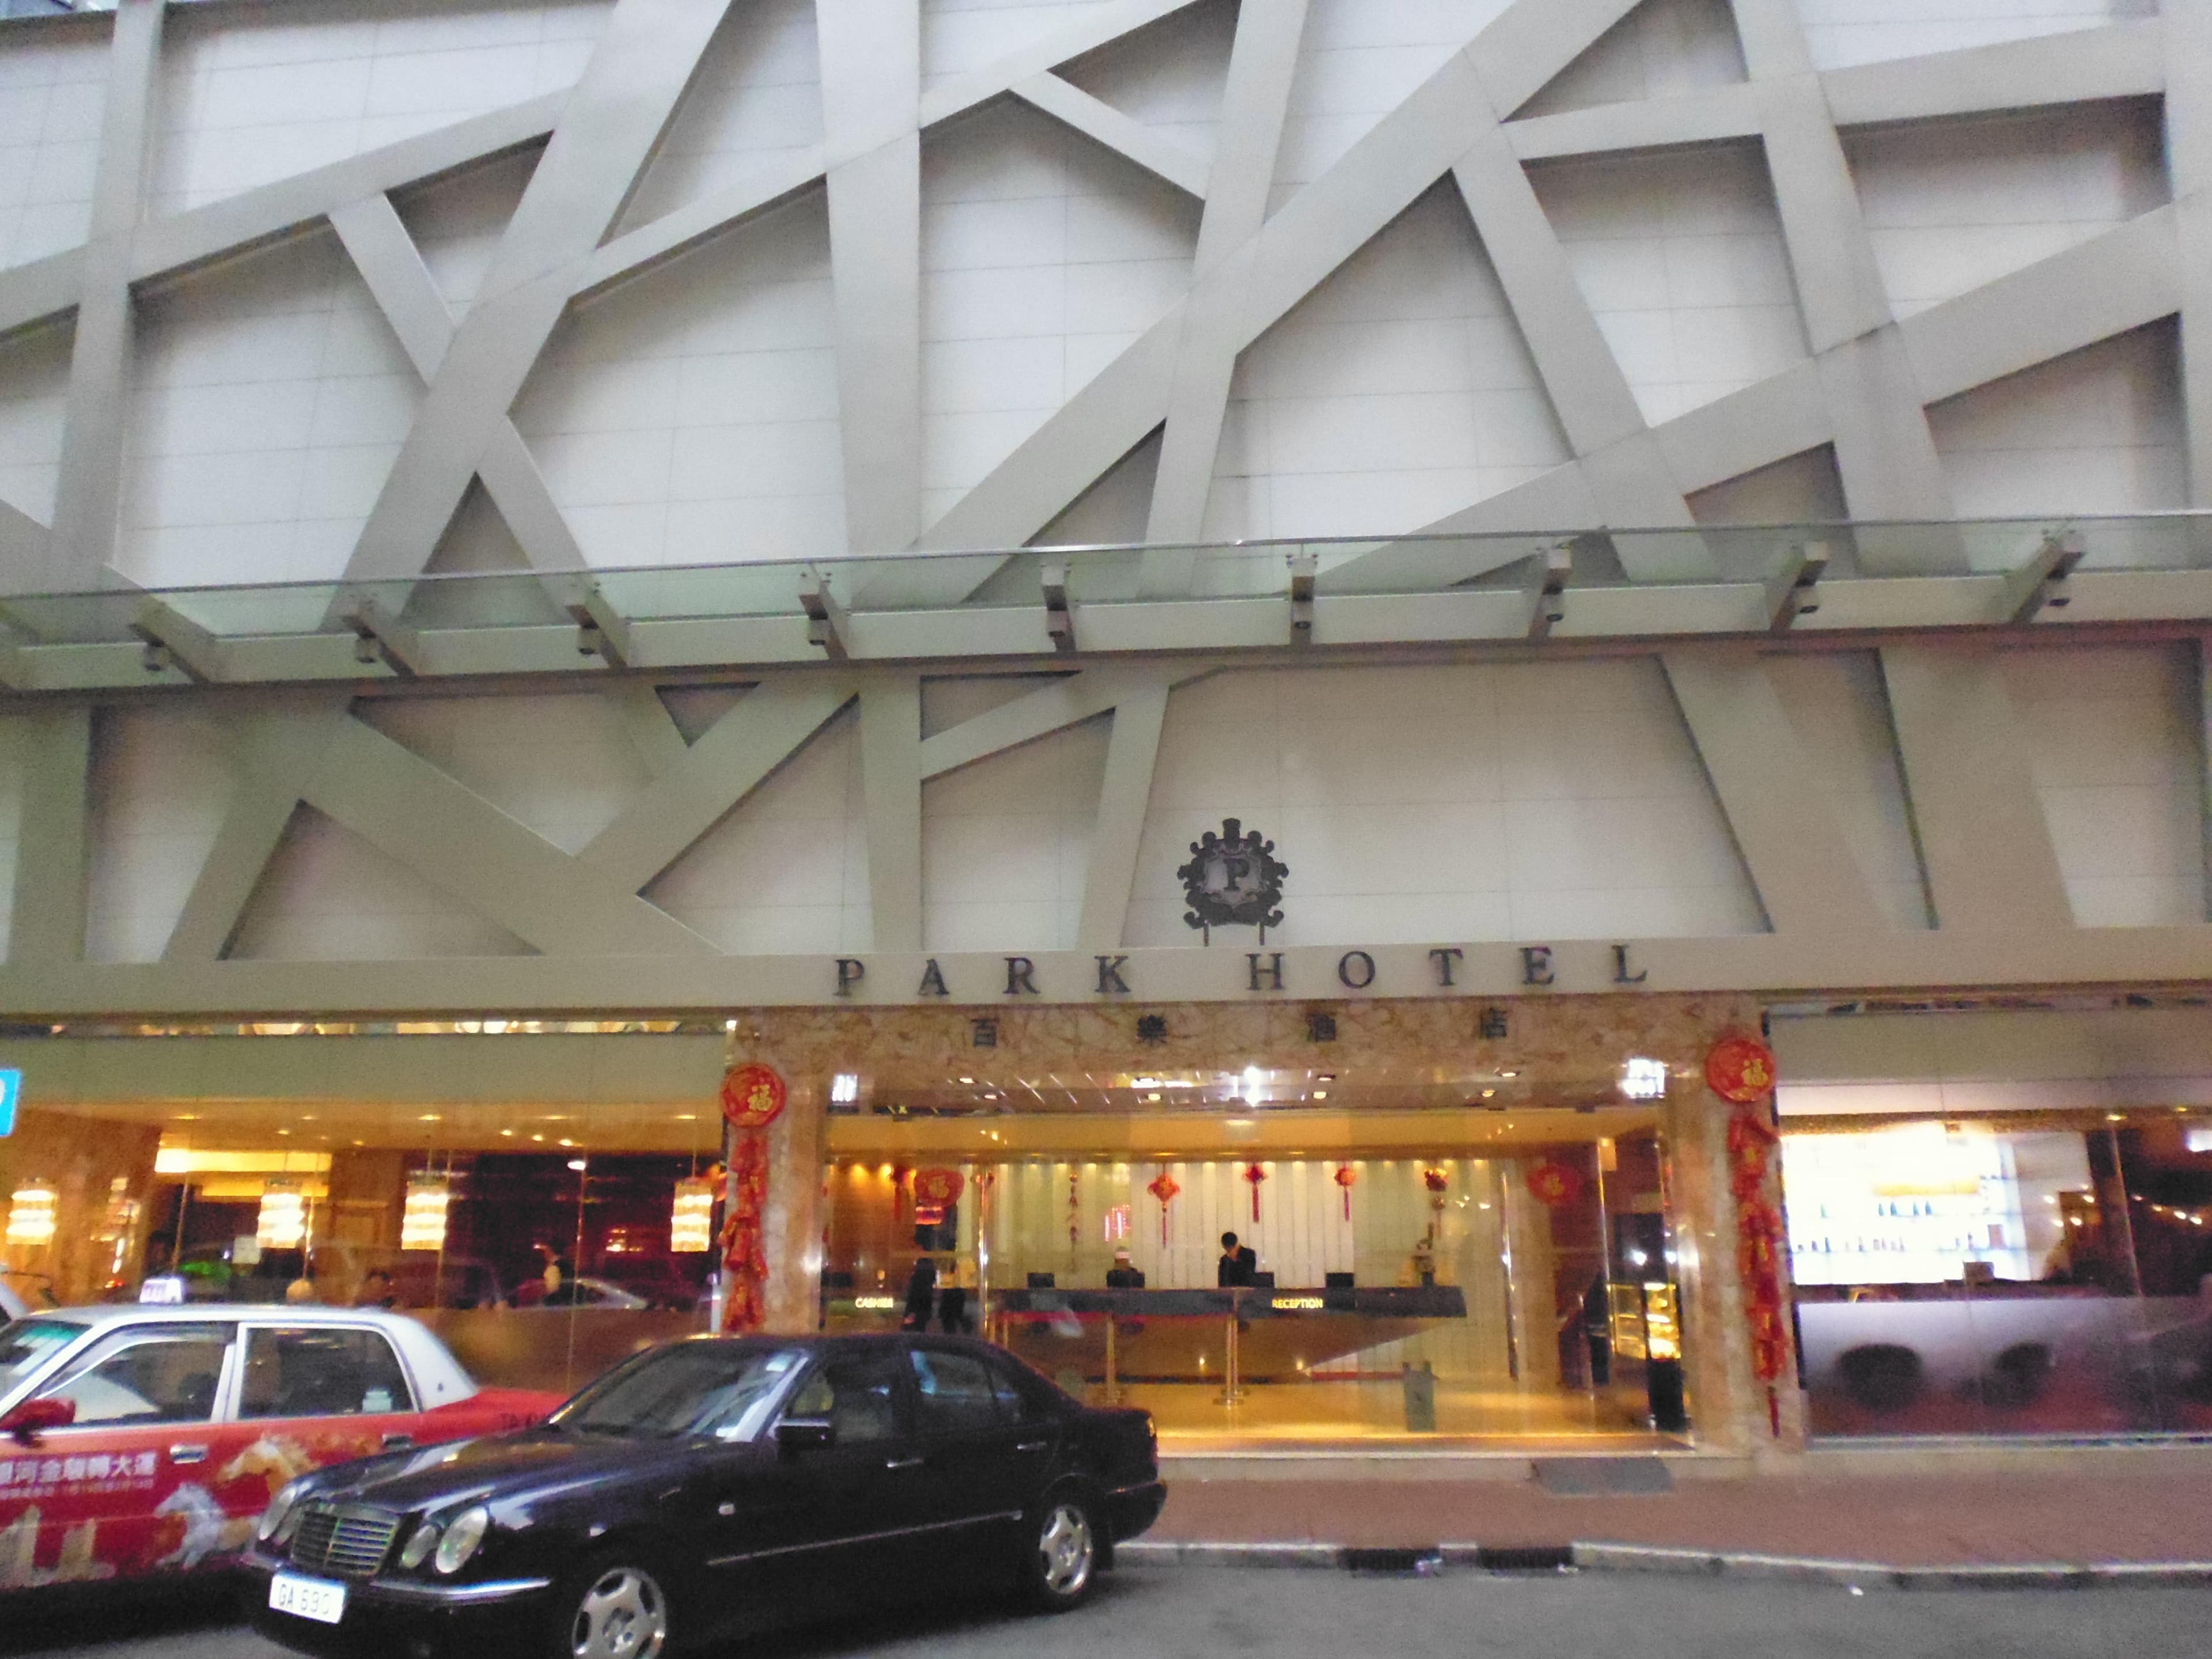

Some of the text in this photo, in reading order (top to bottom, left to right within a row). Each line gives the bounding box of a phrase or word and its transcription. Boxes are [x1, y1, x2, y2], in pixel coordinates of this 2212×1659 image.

[1224, 858, 1249, 891] P
[833, 945, 1647, 996] PARK HOTEL
[1271, 1297, 1323, 1309] RECEPTION
